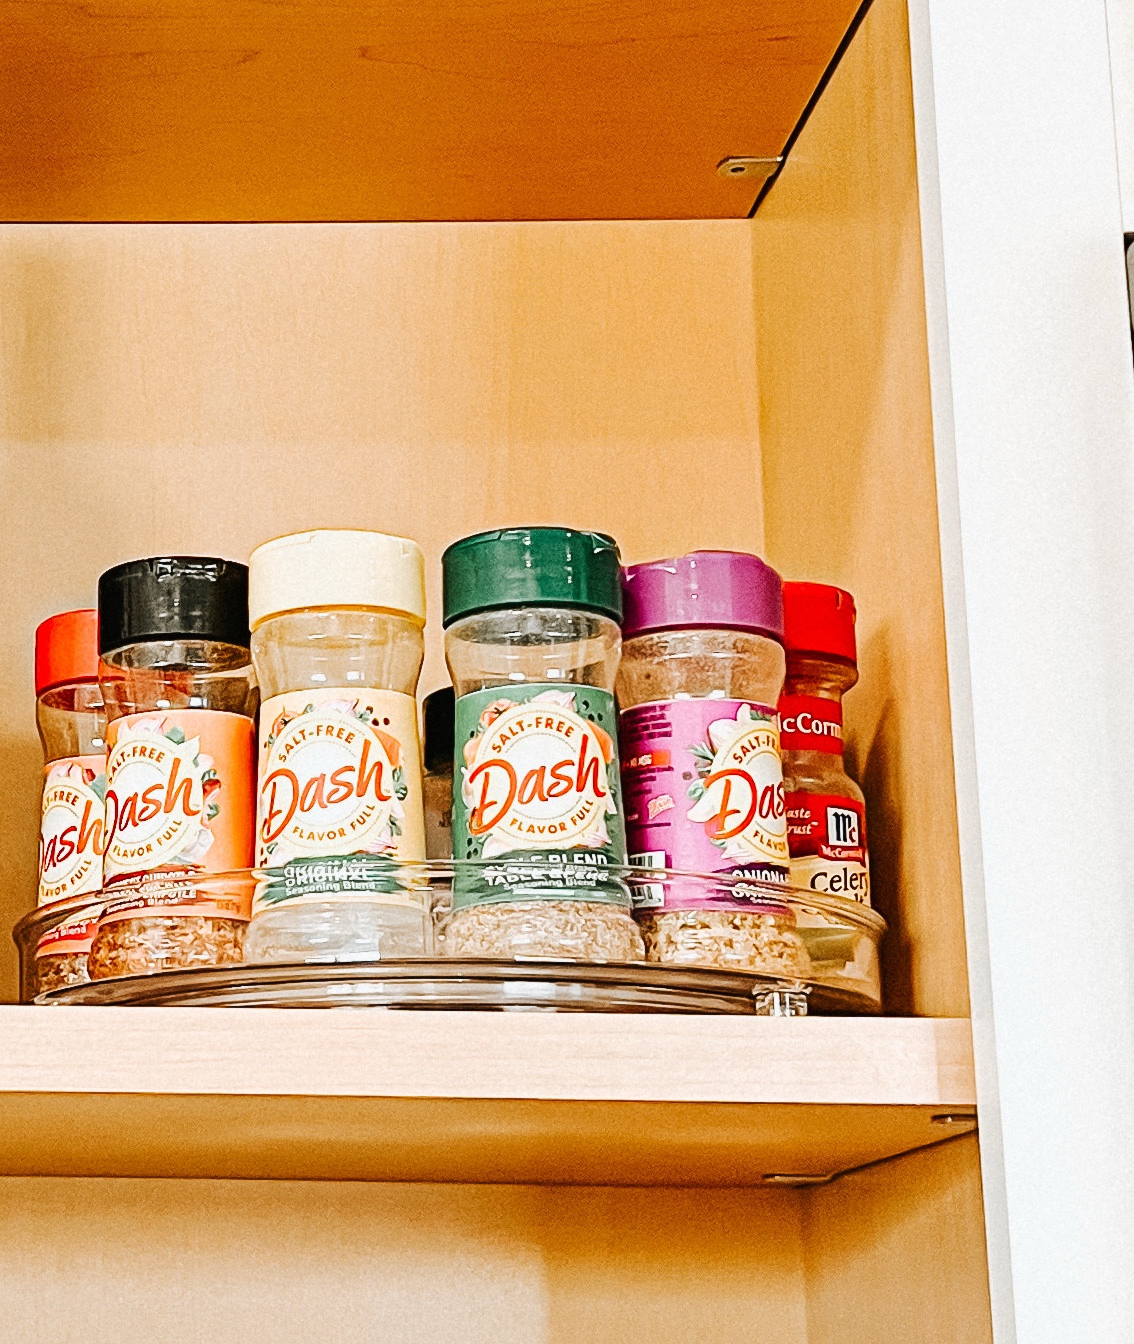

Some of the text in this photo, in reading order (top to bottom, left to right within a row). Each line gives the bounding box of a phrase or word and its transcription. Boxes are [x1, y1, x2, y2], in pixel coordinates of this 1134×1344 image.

[279, 724, 357, 763] SALT-FREE
[491, 716, 576, 754] SALT-FREE
[260, 738, 393, 844] Dash
[468, 733, 607, 836] Dash
[292, 804, 376, 842] FLAVOR FULL
[509, 798, 595, 835] FLAVOR FULL
[787, 807, 811, 819] aste
[787, 823, 812, 836] rust
[831, 811, 857, 845] Mc
[42, 799, 104, 873] ash
[156, 818, 182, 847] FULL
[69, 859, 93, 886] FULL
[285, 882, 341, 897] Seasoning
